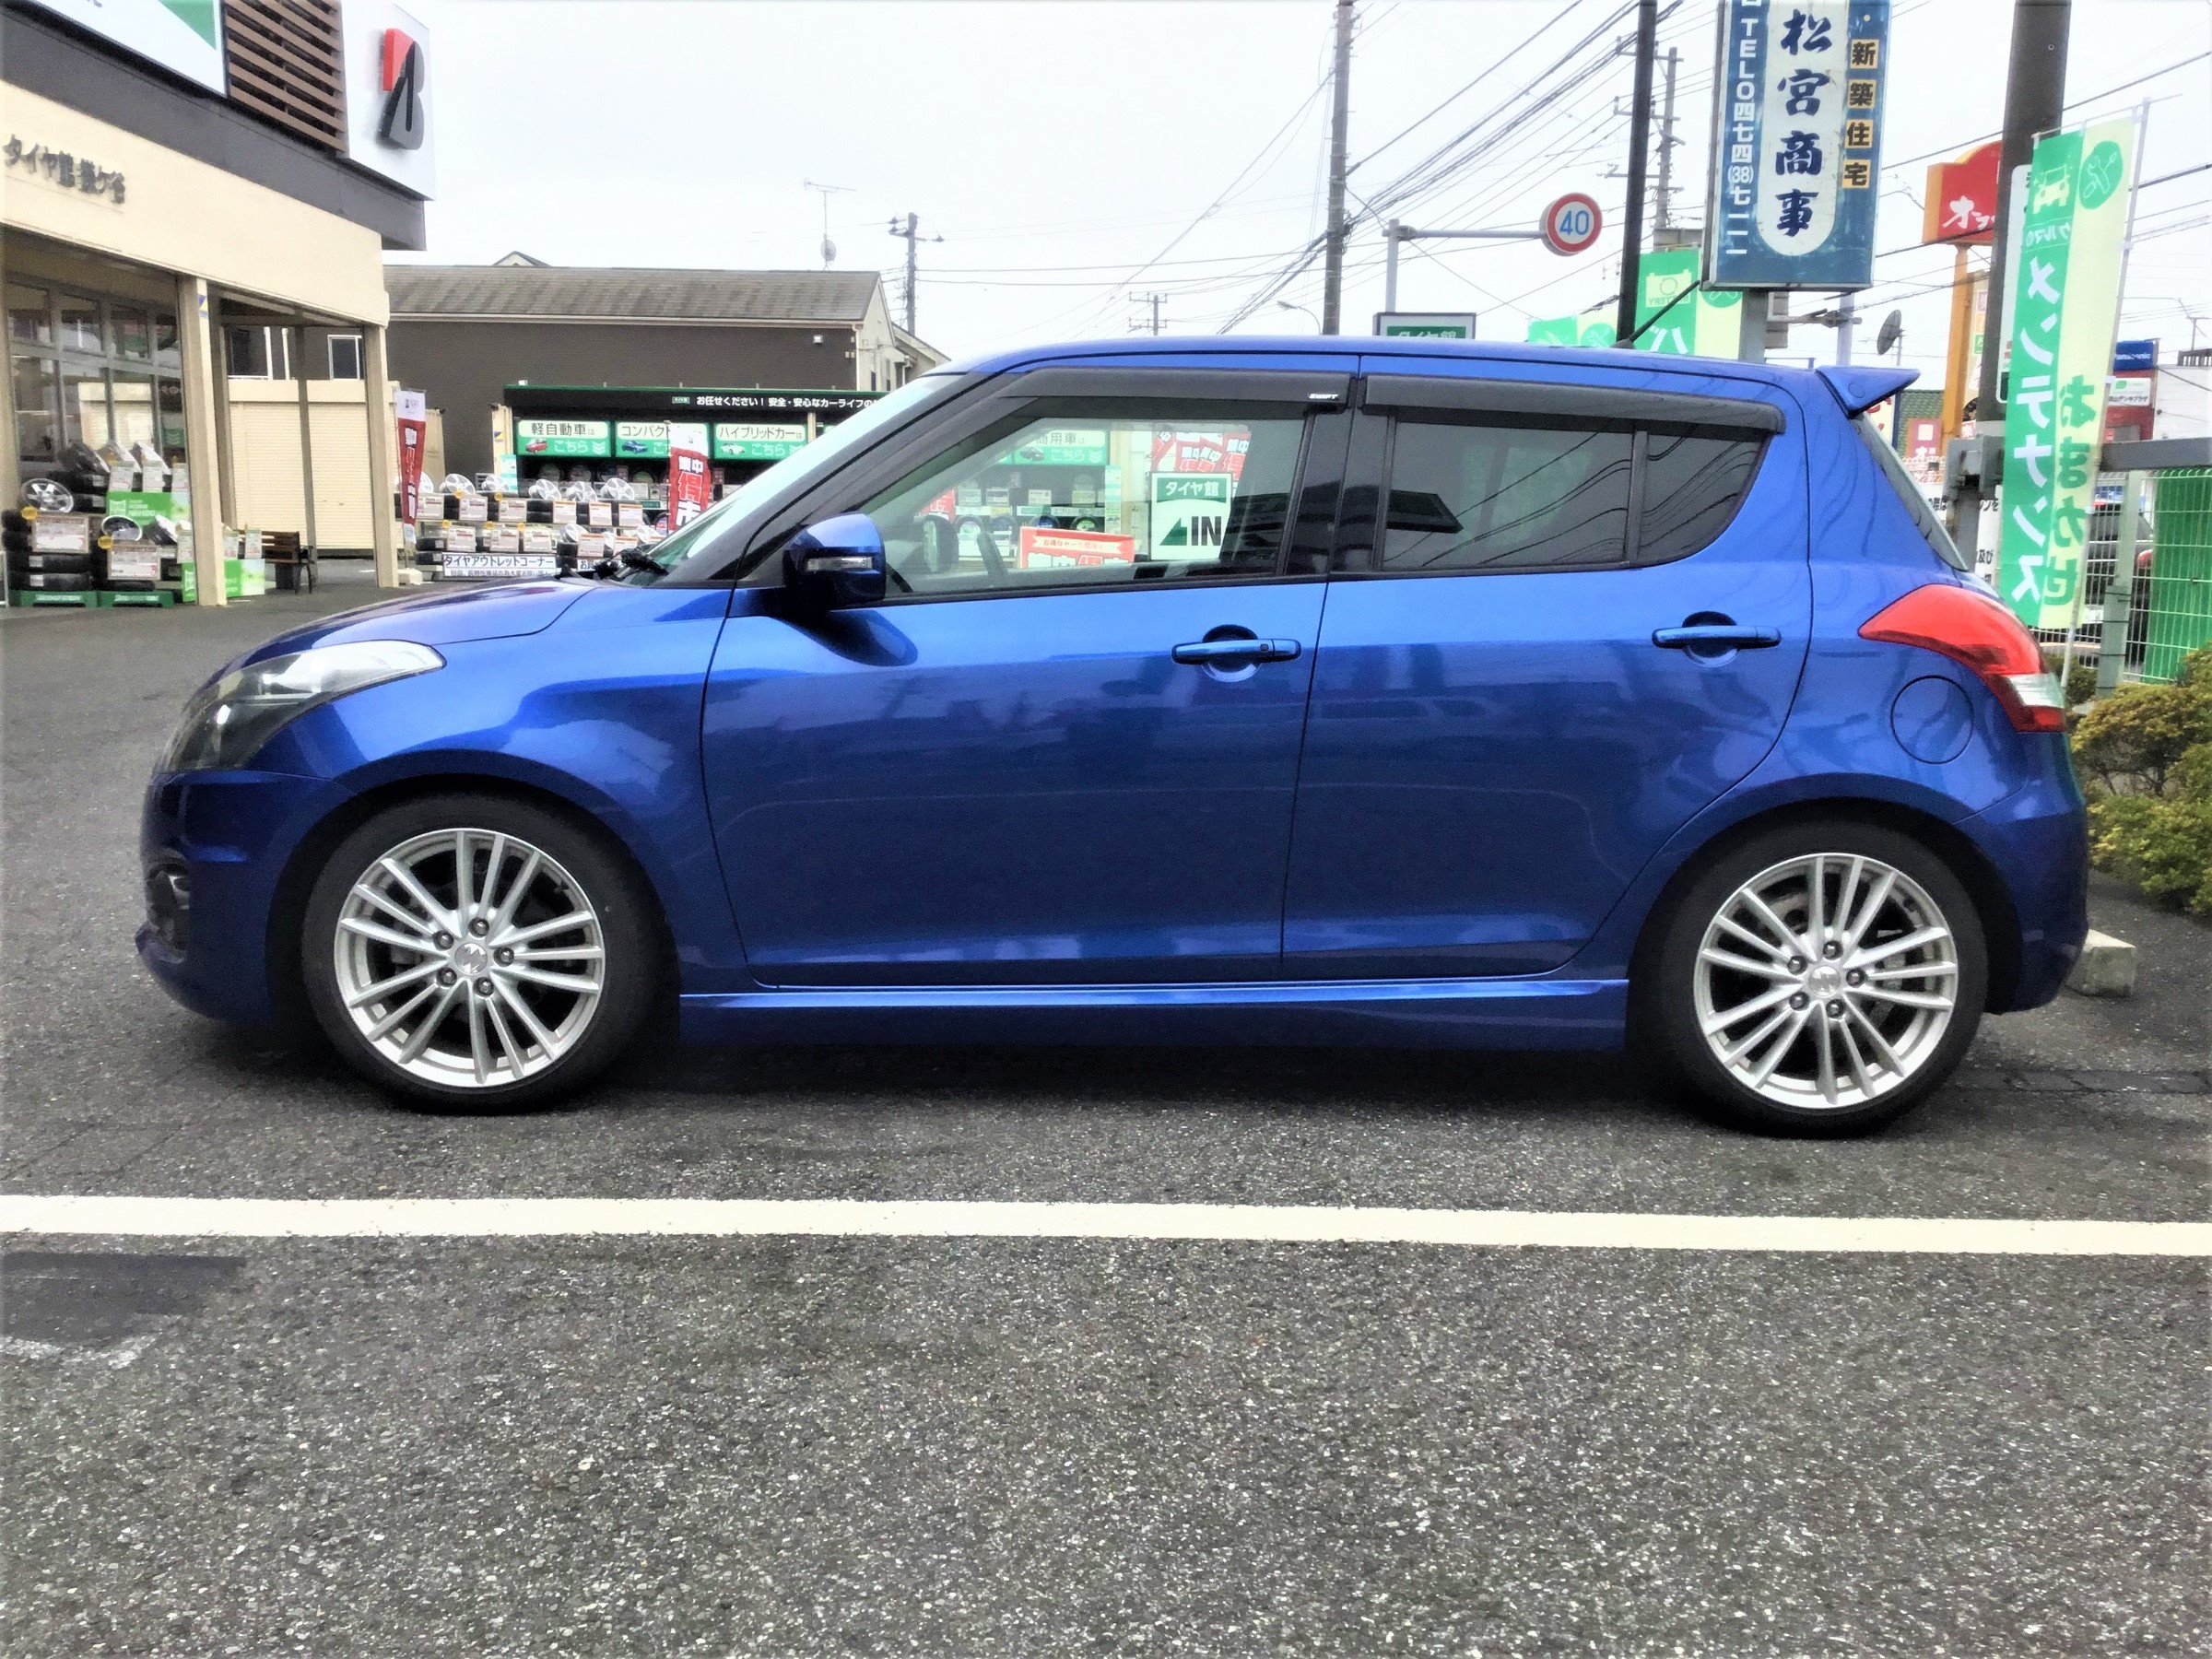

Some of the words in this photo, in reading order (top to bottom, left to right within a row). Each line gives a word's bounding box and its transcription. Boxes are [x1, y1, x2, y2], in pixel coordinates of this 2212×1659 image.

[1776, 8, 1832, 238] 松宮商事
[1843, 41, 1877, 187] 新築住宅
[1559, 209, 1590, 236] 40
[1942, 194, 1996, 230] オラ
[555, 441, 589, 453] こちら
[751, 444, 786, 455] こちら
[1051, 449, 1085, 462] こちら
[1165, 481, 1219, 497] タイヤ館
[1191, 516, 1221, 546] IN
[444, 556, 554, 568] タイヤアウトレットコーナー
